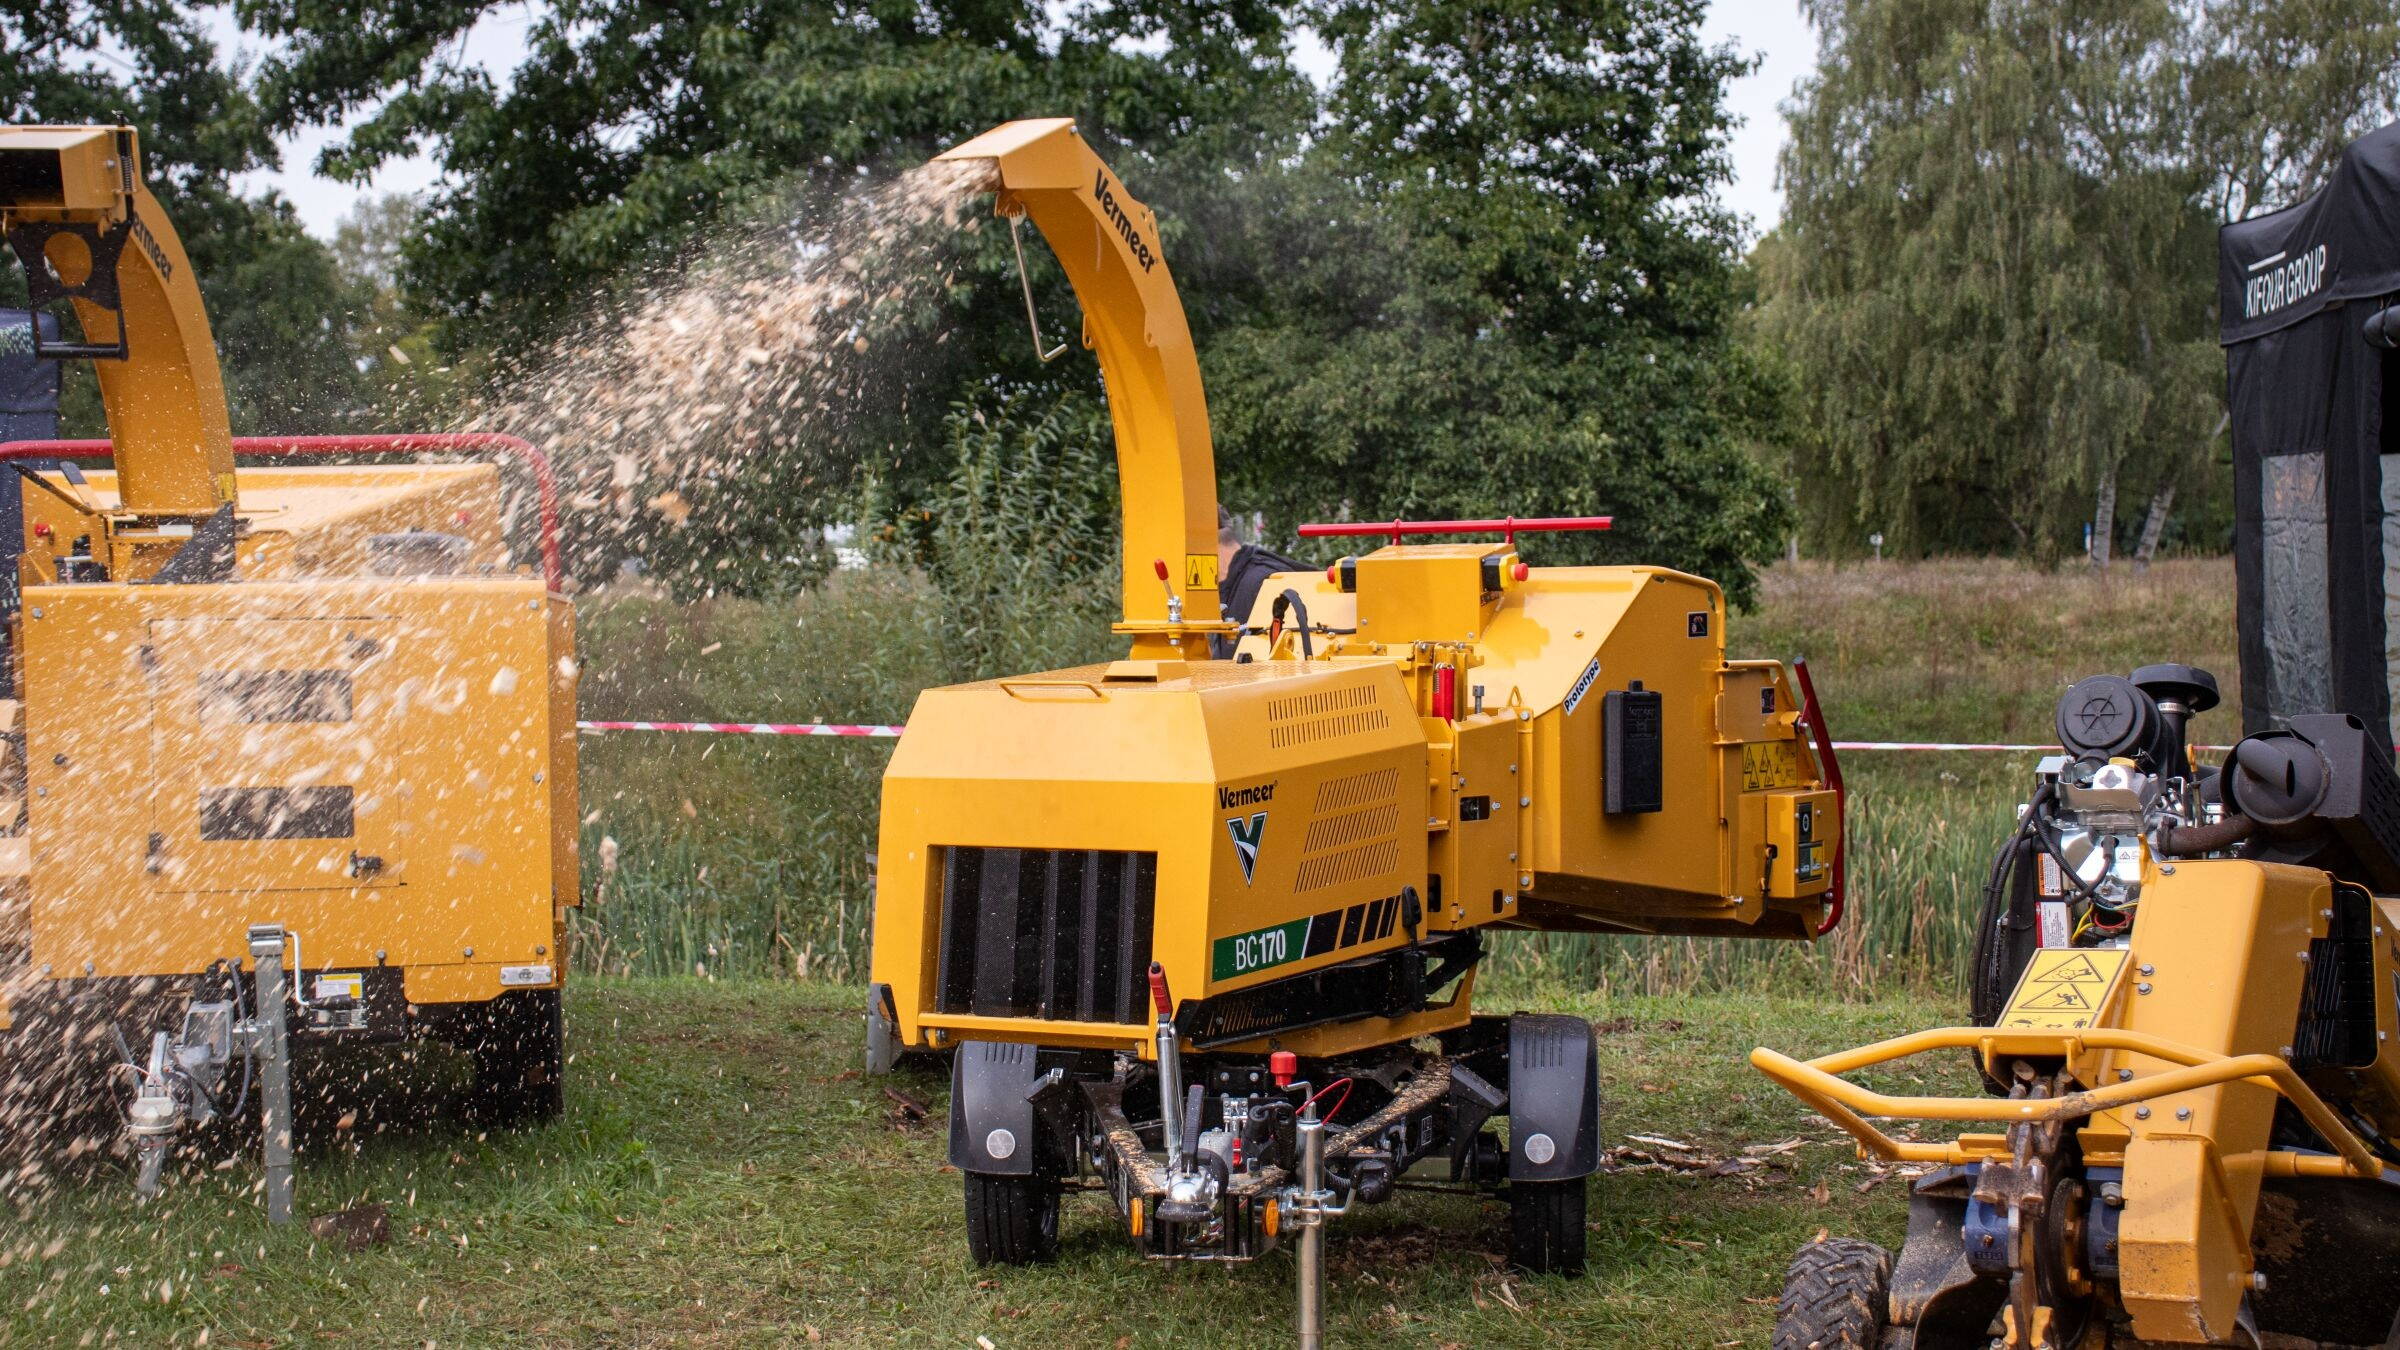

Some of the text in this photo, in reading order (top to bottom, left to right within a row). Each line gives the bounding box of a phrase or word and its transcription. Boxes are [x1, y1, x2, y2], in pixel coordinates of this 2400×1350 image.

[132, 209, 172, 284] ermeer
[1094, 167, 1156, 274] Vermeer
[2246, 244, 2327, 319] KIFOUR GROUP
[1564, 661, 1599, 712] Prototype
[1218, 783, 1274, 810] Vermeer
